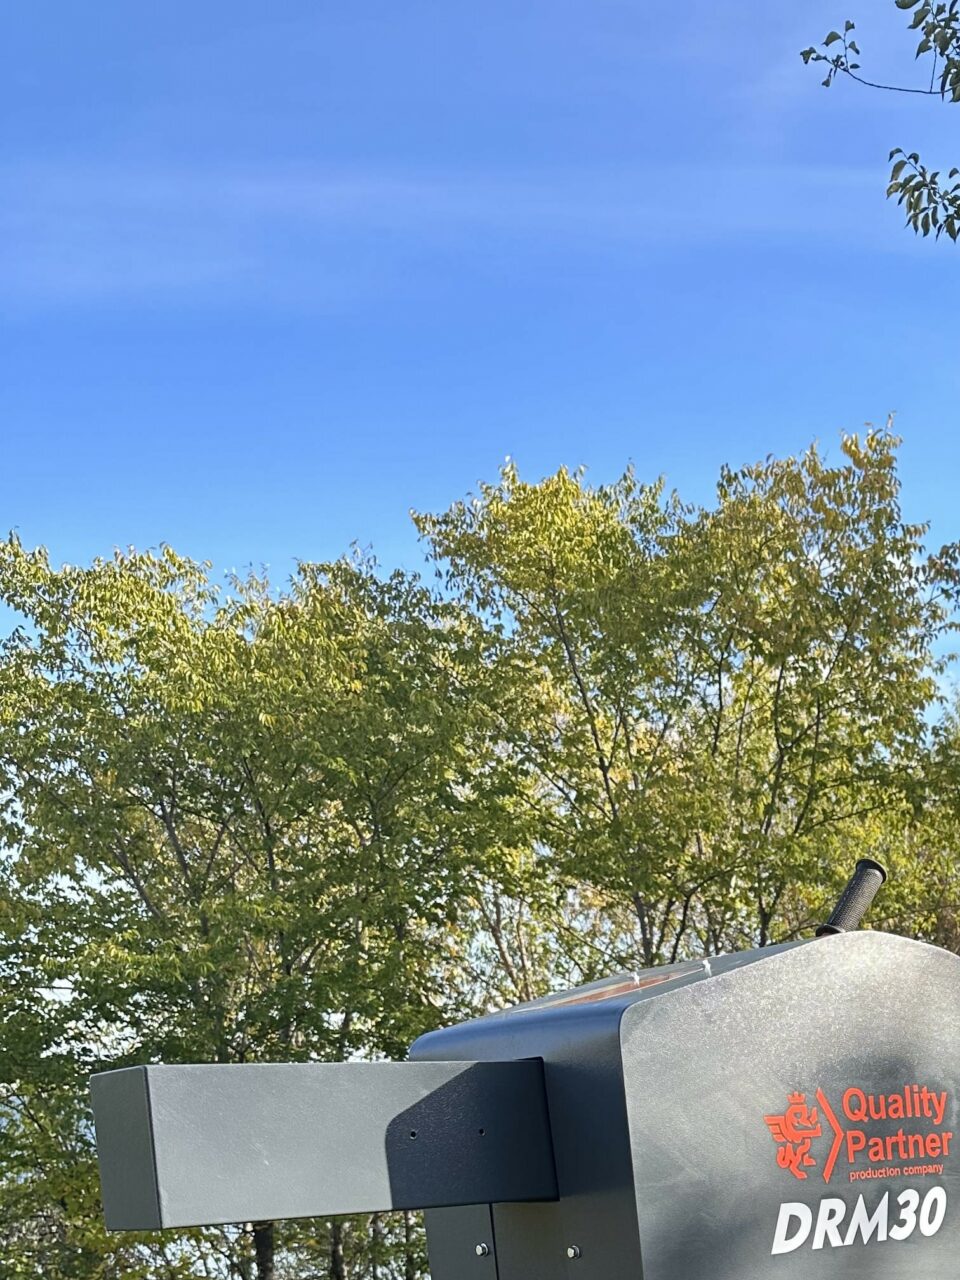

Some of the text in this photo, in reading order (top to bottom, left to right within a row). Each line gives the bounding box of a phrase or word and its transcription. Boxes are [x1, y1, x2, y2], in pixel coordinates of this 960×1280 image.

[842, 1084, 947, 1125] Quality
[846, 1128, 953, 1163] Partner
[849, 1163, 944, 1183] production company
[770, 1185, 947, 1255] DRM30
